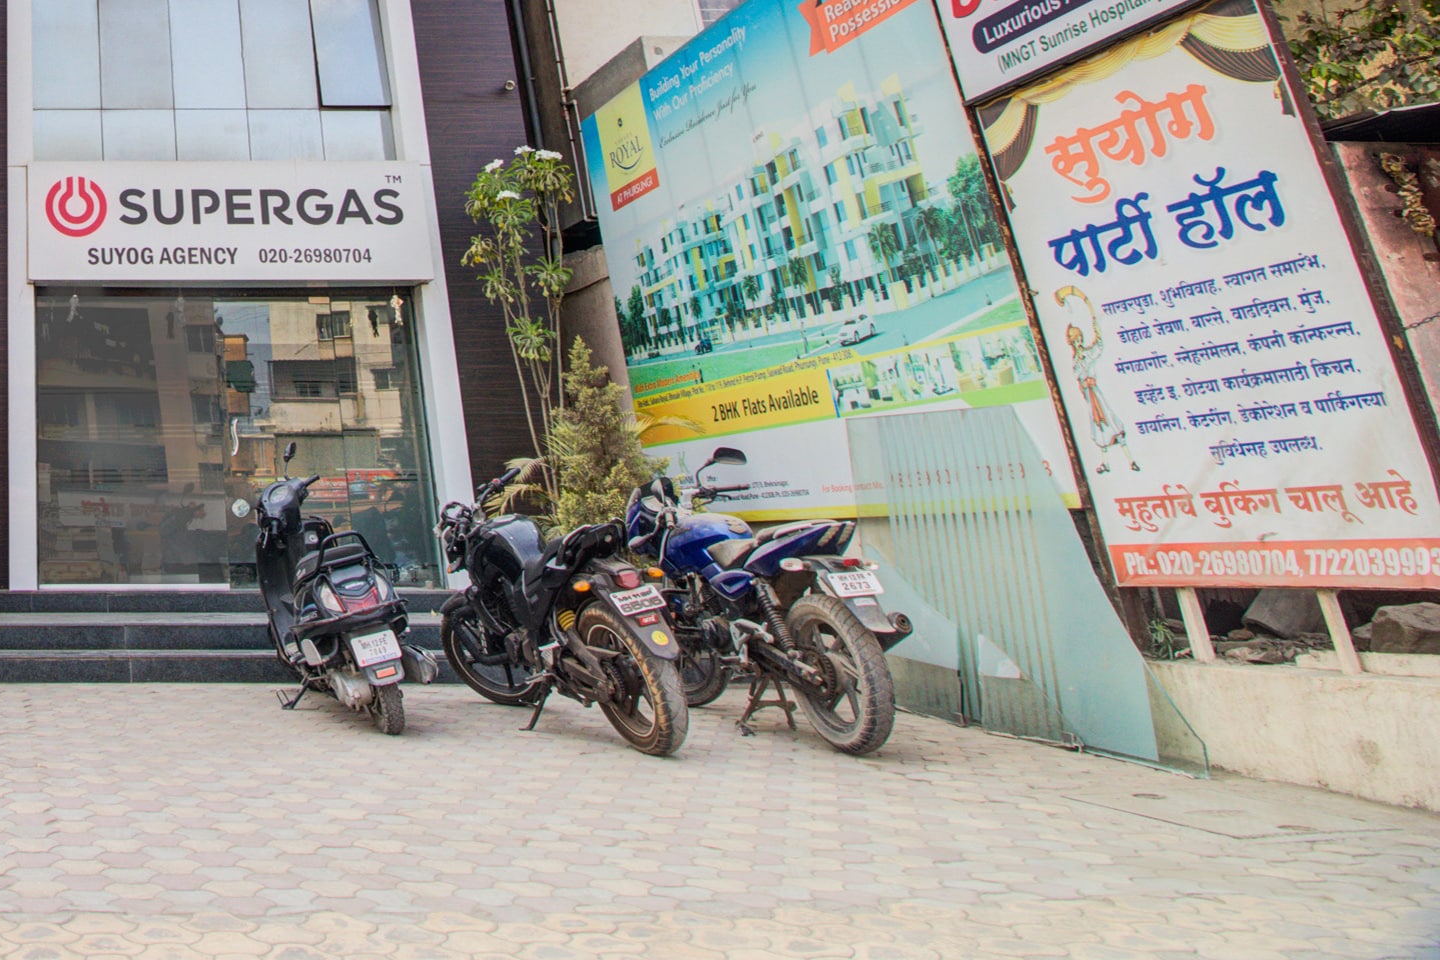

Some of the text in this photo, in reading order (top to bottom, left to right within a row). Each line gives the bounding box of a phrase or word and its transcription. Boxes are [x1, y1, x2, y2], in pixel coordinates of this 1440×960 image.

[649, 26, 747, 102] Building Your Personality
[998, 33, 1037, 74] (MNGT
[1039, 17, 1087, 54] Sunrise
[652, 62, 734, 121] With Our Proficiency
[609, 135, 644, 168] ROYAL
[1044, 83, 1215, 204] सुयोग
[118, 175, 404, 226] SUPERGAS TM
[1047, 166, 1285, 277] पार्टी हॉल
[87, 247, 372, 265] SUYOG AGENCY 020-26980704
[1223, 267, 1267, 288] स्वागत
[1247, 329, 1286, 353] कंपनी
[711, 405, 719, 422] 2
[719, 401, 741, 422] BHK
[742, 396, 767, 417] Flats
[768, 385, 820, 415] Available
[1237, 400, 1298, 423] डेकोरेशन
[1300, 401, 1312, 415] व
[1200, 480, 1282, 529] बुकिंग
[1284, 484, 1364, 525] चालू
[1355, 469, 1418, 515] आहे
[842, 581, 871, 591] 2673
